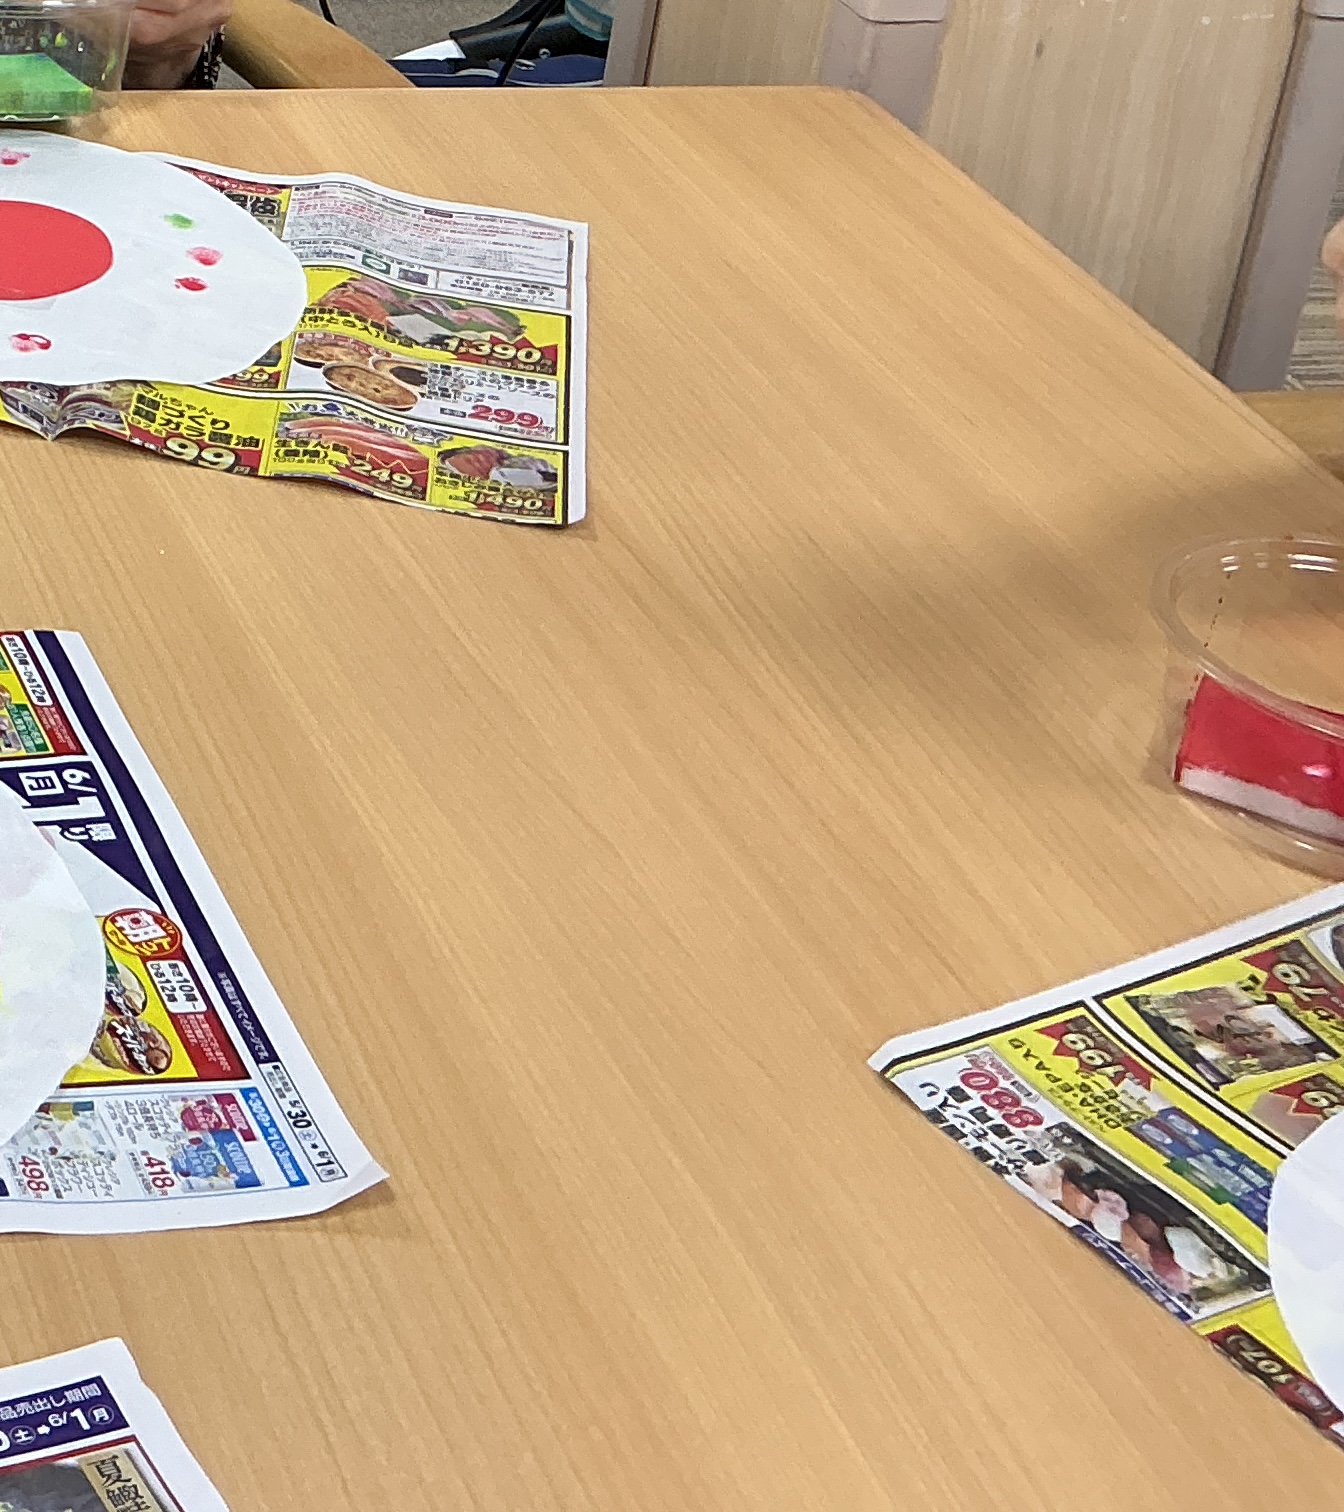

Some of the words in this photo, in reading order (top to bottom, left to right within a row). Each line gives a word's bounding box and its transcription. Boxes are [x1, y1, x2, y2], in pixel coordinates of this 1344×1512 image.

[469, 404, 544, 428] 299
[350, 459, 414, 488] 249
[956, 1064, 1045, 1133] 880
[49, 1408, 90, 1431] 6/1
